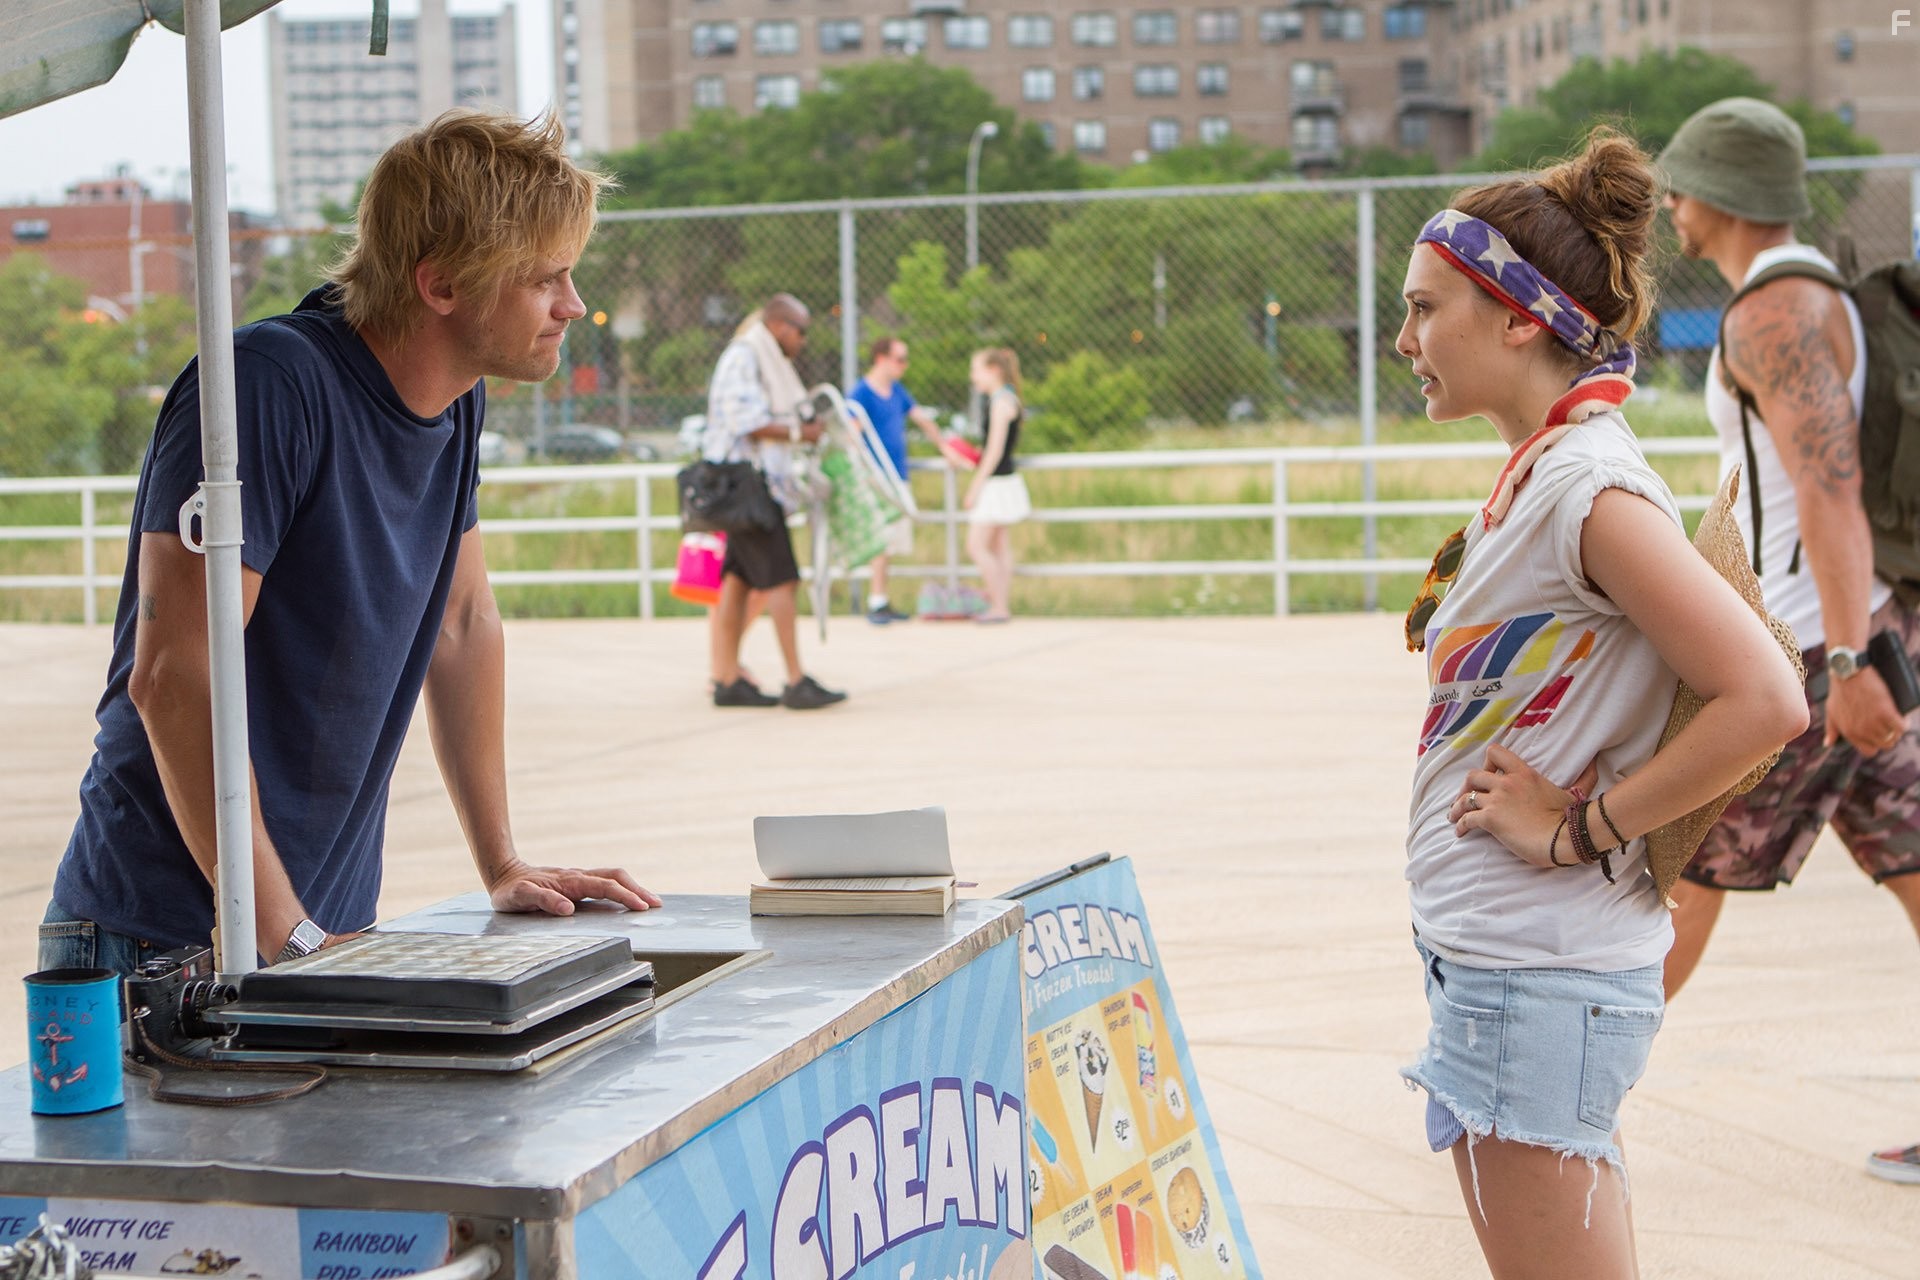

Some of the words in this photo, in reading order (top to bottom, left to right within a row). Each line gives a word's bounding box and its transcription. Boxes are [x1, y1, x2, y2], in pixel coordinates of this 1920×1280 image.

[1024, 903, 1153, 979] CREAM
[1033, 975, 1074, 1009] Frozen
[1073, 961, 1115, 988] Treats!
[770, 1077, 1027, 1280] CREAM
[63, 1216, 138, 1239] NUTTY
[137, 1220, 175, 1241] ICE
[313, 1231, 420, 1255] RAINBOW
[80, 1250, 138, 1272] REAM
